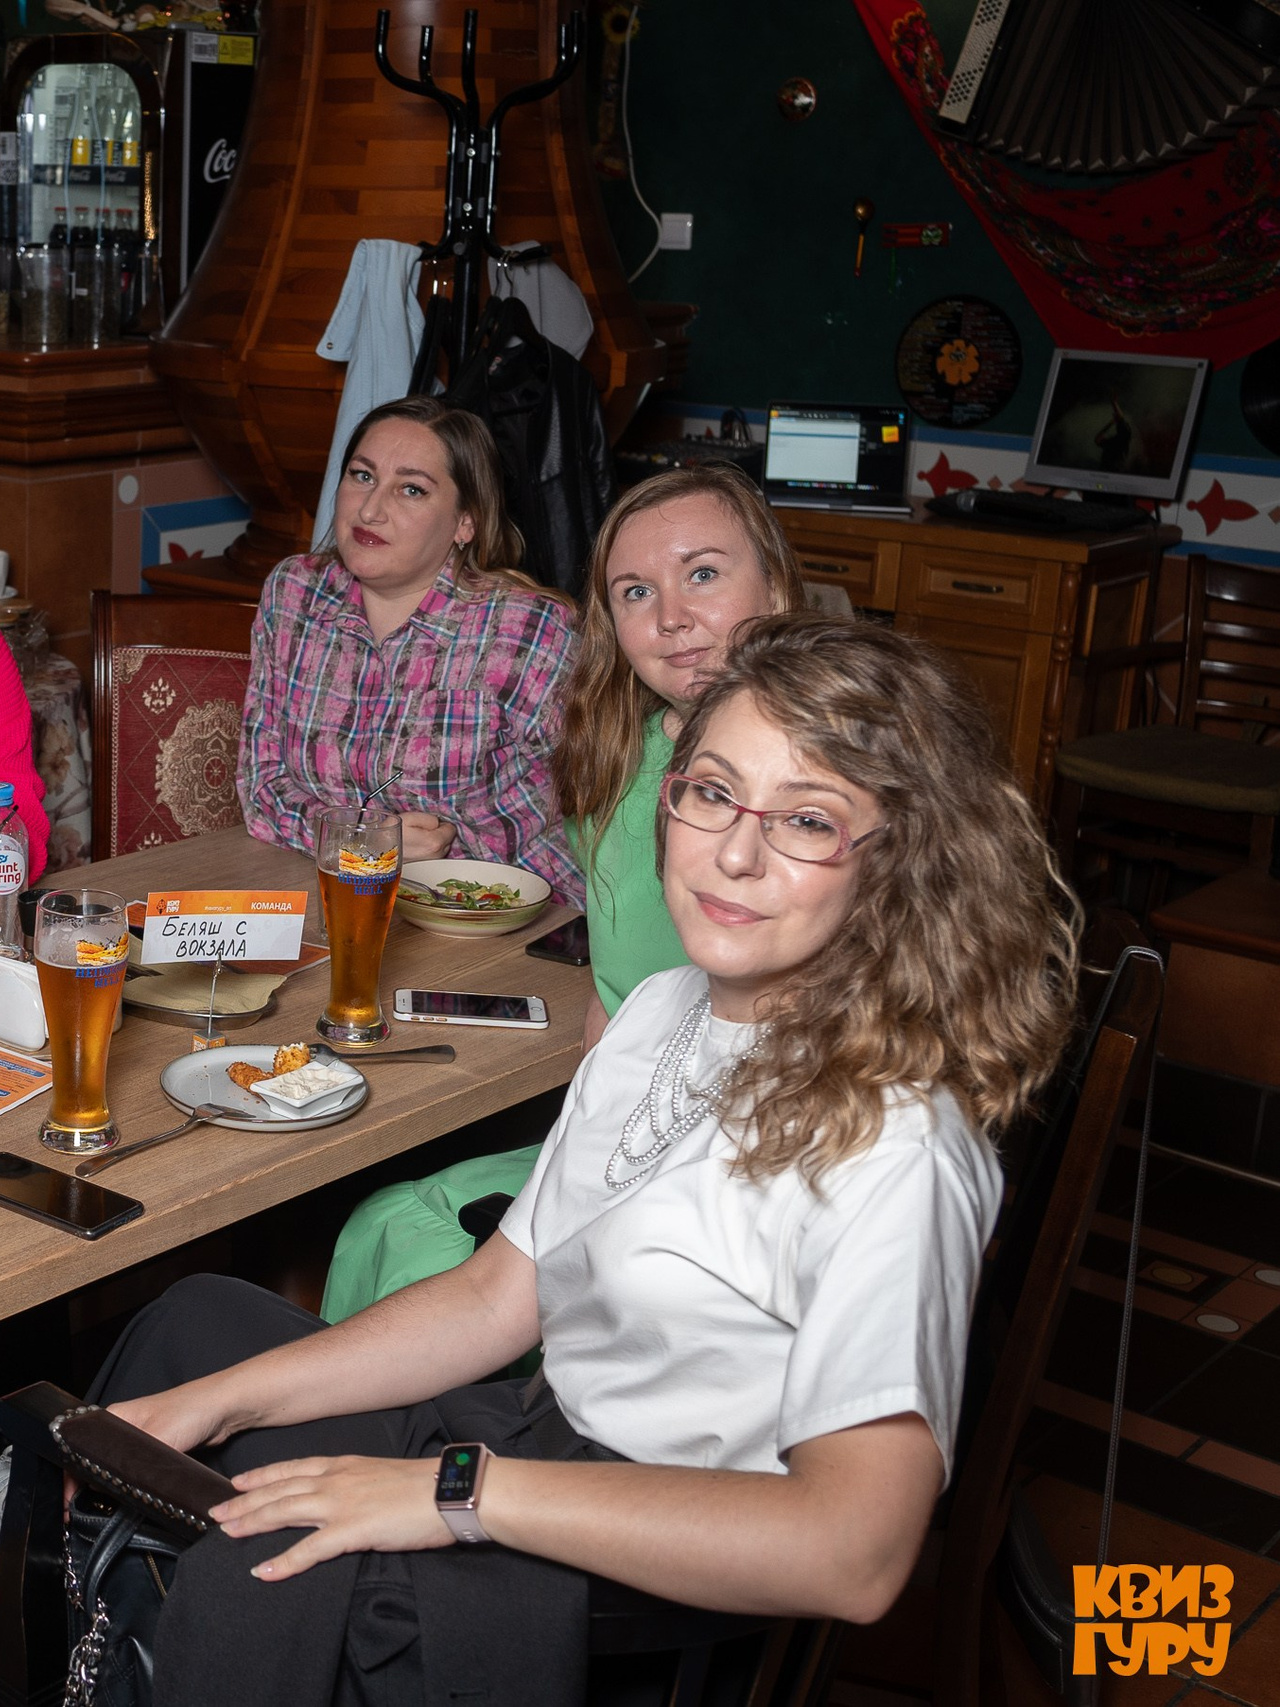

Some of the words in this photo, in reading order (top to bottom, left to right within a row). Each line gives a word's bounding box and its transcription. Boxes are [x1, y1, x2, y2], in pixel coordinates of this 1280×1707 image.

[203, 138, 237, 183] Coc
[250, 902, 293, 911] КОМАНДА
[162, 916, 223, 937] БЕЛЯШ
[176, 939, 247, 958] ВОКЗАЛА
